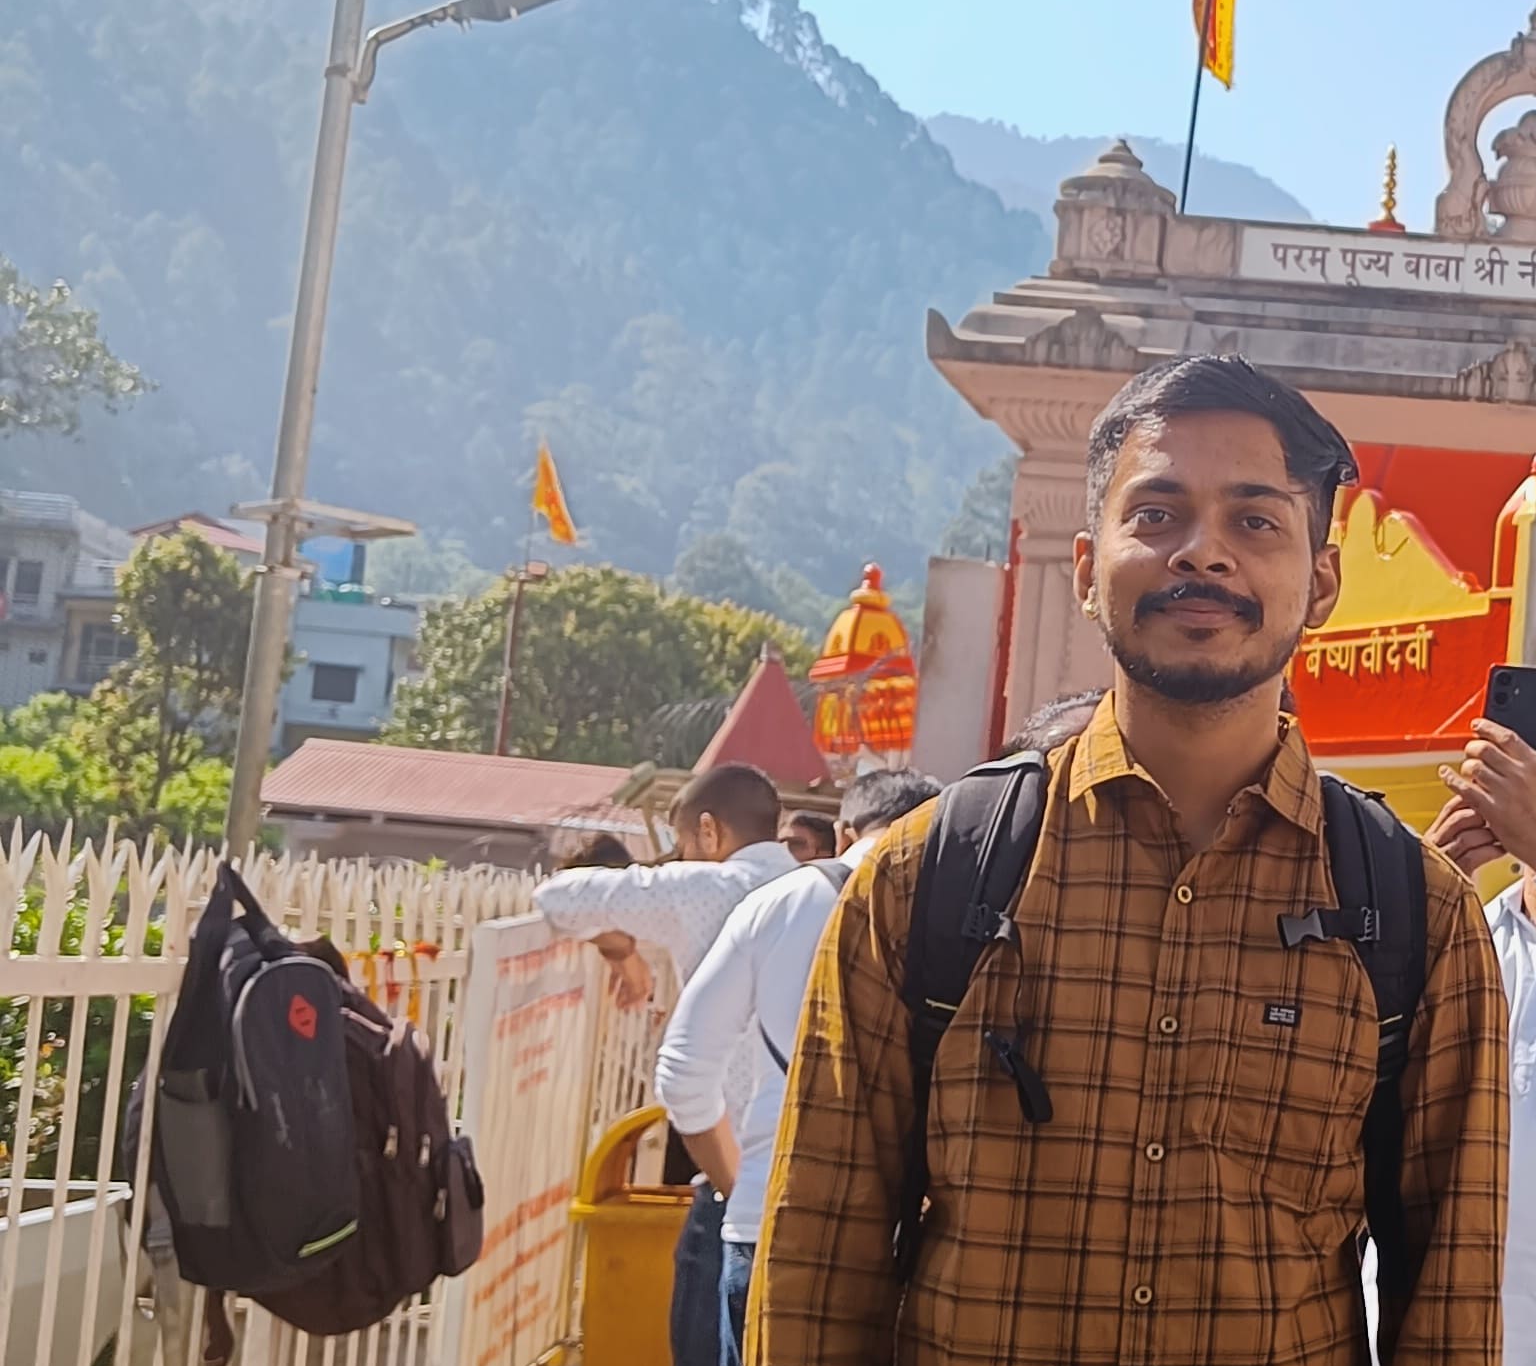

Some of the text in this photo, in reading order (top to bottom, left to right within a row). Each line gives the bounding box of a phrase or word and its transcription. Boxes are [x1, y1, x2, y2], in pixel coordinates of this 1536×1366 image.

[1271, 243, 1330, 283] परम्
[1340, 248, 1394, 287] पूज्य
[1403, 252, 1465, 282] बाबा
[1474, 246, 1508, 286] श्री
